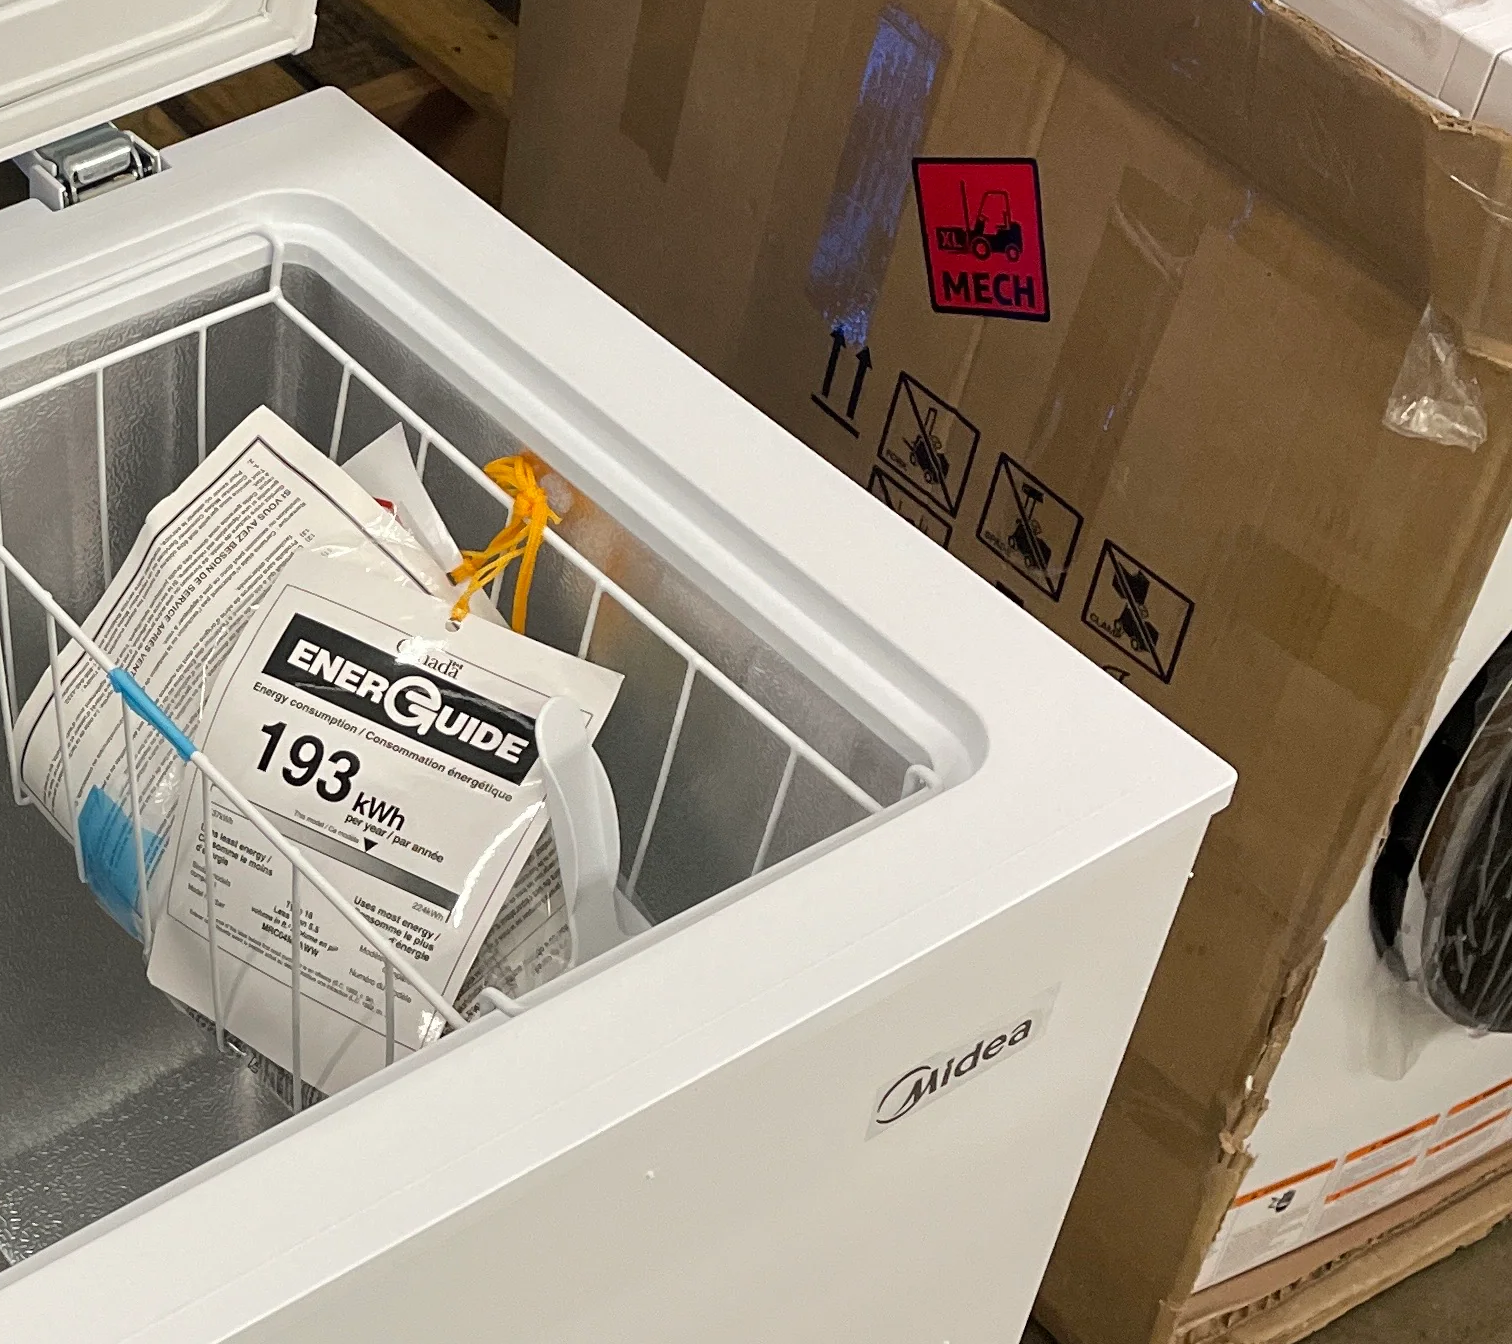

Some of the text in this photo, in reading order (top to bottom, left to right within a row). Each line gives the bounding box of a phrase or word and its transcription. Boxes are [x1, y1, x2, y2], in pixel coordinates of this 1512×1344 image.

[940, 230, 963, 248] XL
[941, 271, 1036, 308] MECH
[256, 497, 283, 521] VOUS
[234, 518, 258, 543] AVEZ
[204, 539, 238, 573] BESOIN
[192, 570, 208, 586] DE
[163, 583, 196, 623] SERVICE
[126, 652, 147, 678] VENT
[287, 638, 531, 765] ENERGUIDE
[252, 681, 289, 706] Energy
[290, 697, 359, 735] consumption
[365, 729, 446, 774] Consommation
[447, 765, 513, 803] énergétique
[255, 721, 406, 832] 193 kWh
[198, 833, 239, 860] Csomme
[248, 859, 273, 877] moins
[239, 843, 267, 862] energy
[344, 813, 363, 830] per
[363, 819, 386, 840] year
[391, 832, 411, 850] par
[412, 839, 445, 864] année
[353, 895, 434, 941] Uses most energy
[411, 901, 444, 922] 224kWh
[403, 930, 413, 941] le
[413, 935, 435, 952] plus
[875, 1018, 1033, 1124] Midea
